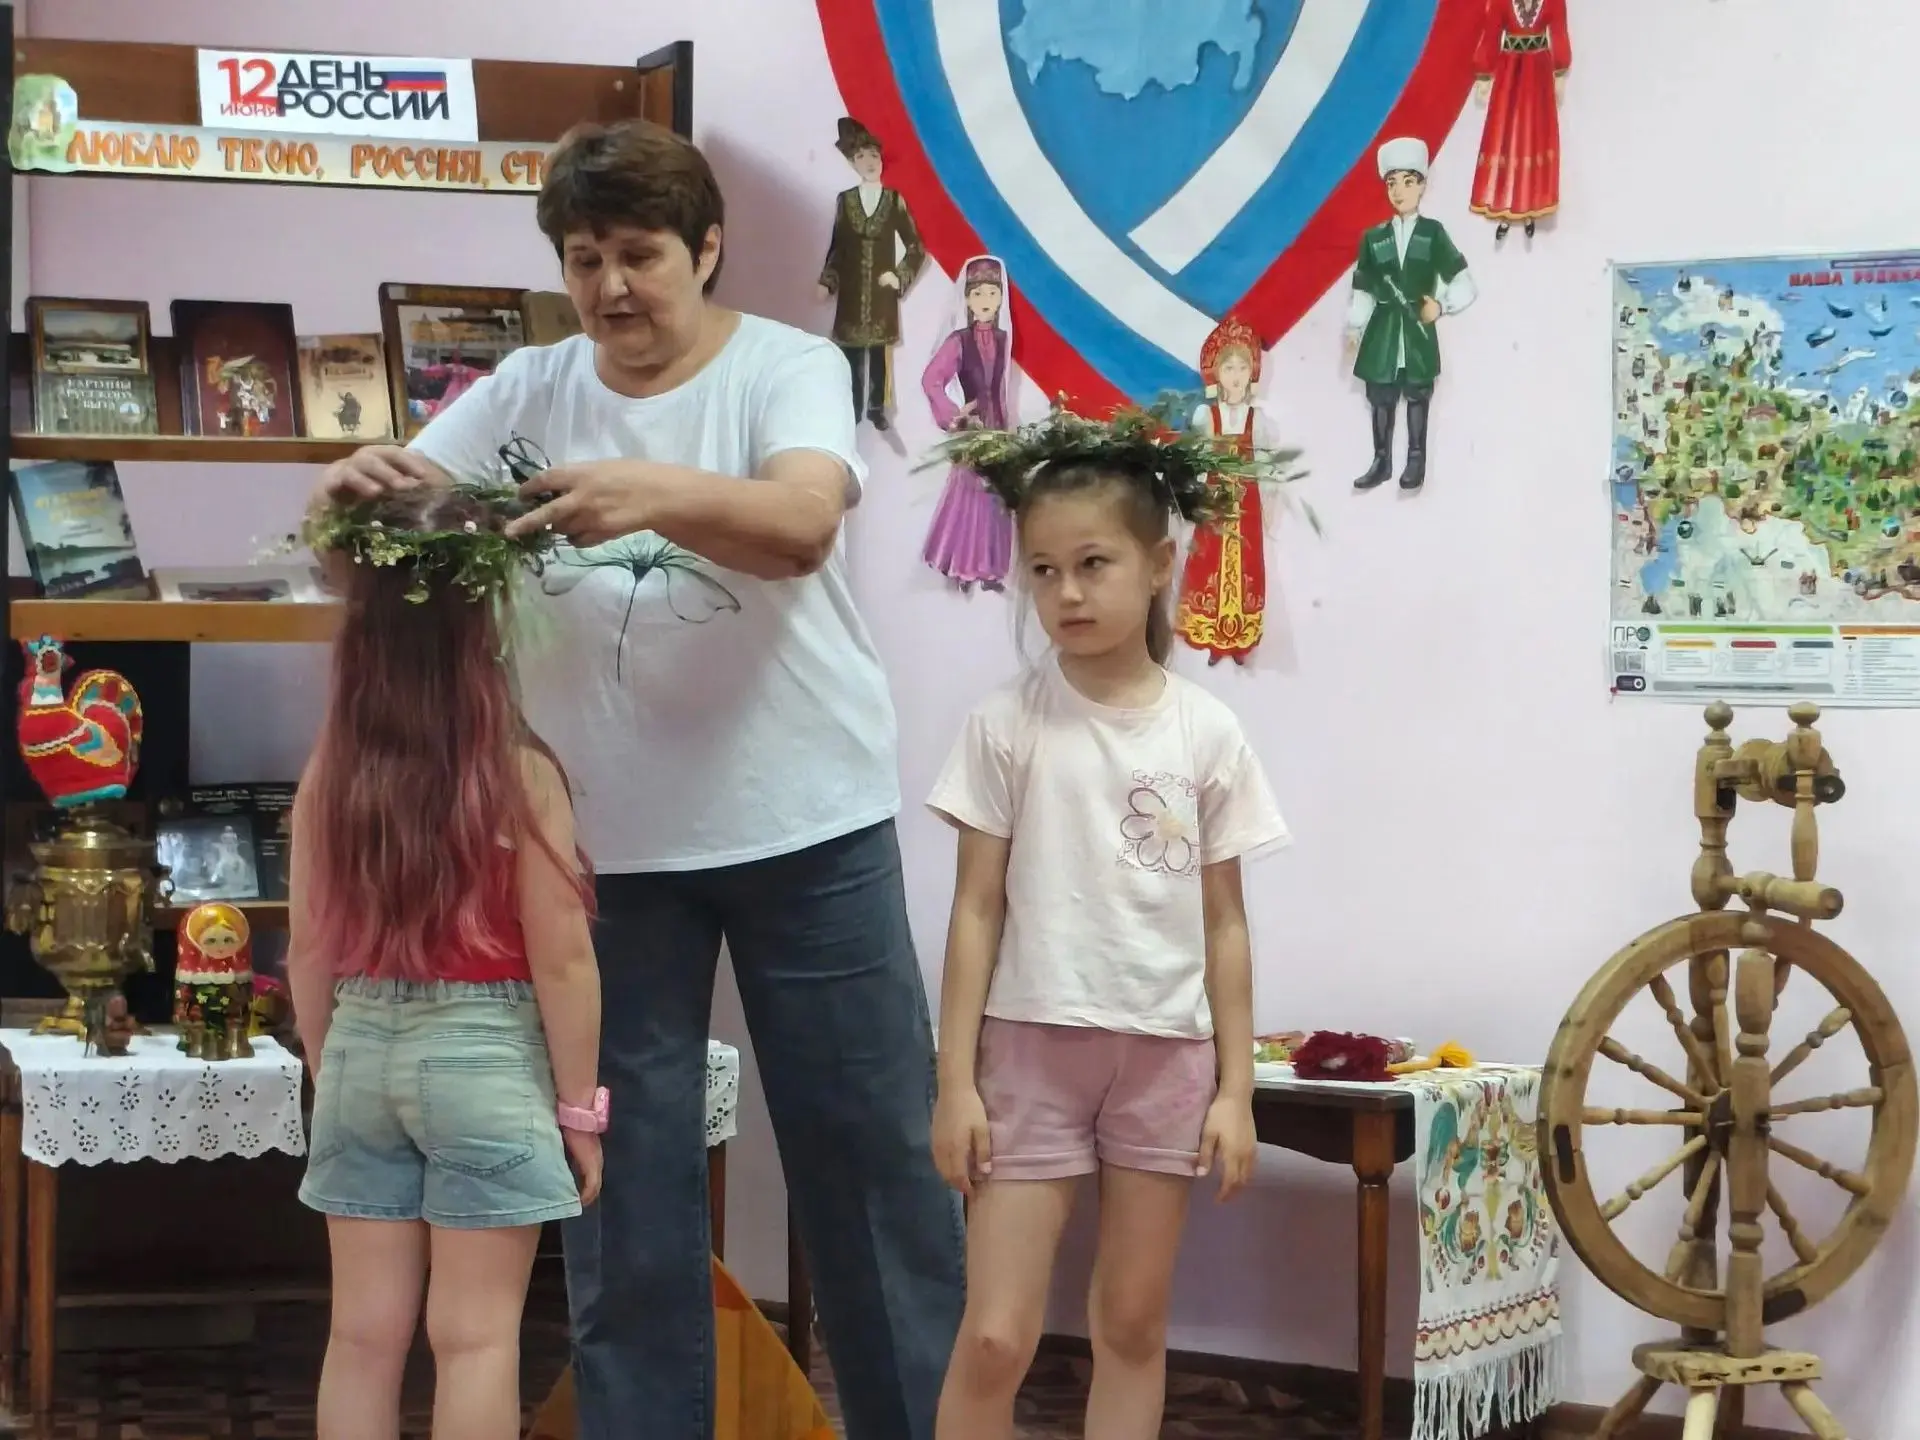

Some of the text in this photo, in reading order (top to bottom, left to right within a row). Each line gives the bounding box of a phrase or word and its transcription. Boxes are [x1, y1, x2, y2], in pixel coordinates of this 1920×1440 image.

[218, 58, 278, 105] 12
[278, 59, 388, 91] ДЕНЬ
[220, 102, 278, 117] ИЮНЯ
[277, 90, 450, 120] РОССИИ
[218, 136, 325, 180] ТВОЮ,
[1788, 271, 1843, 287] НАША
